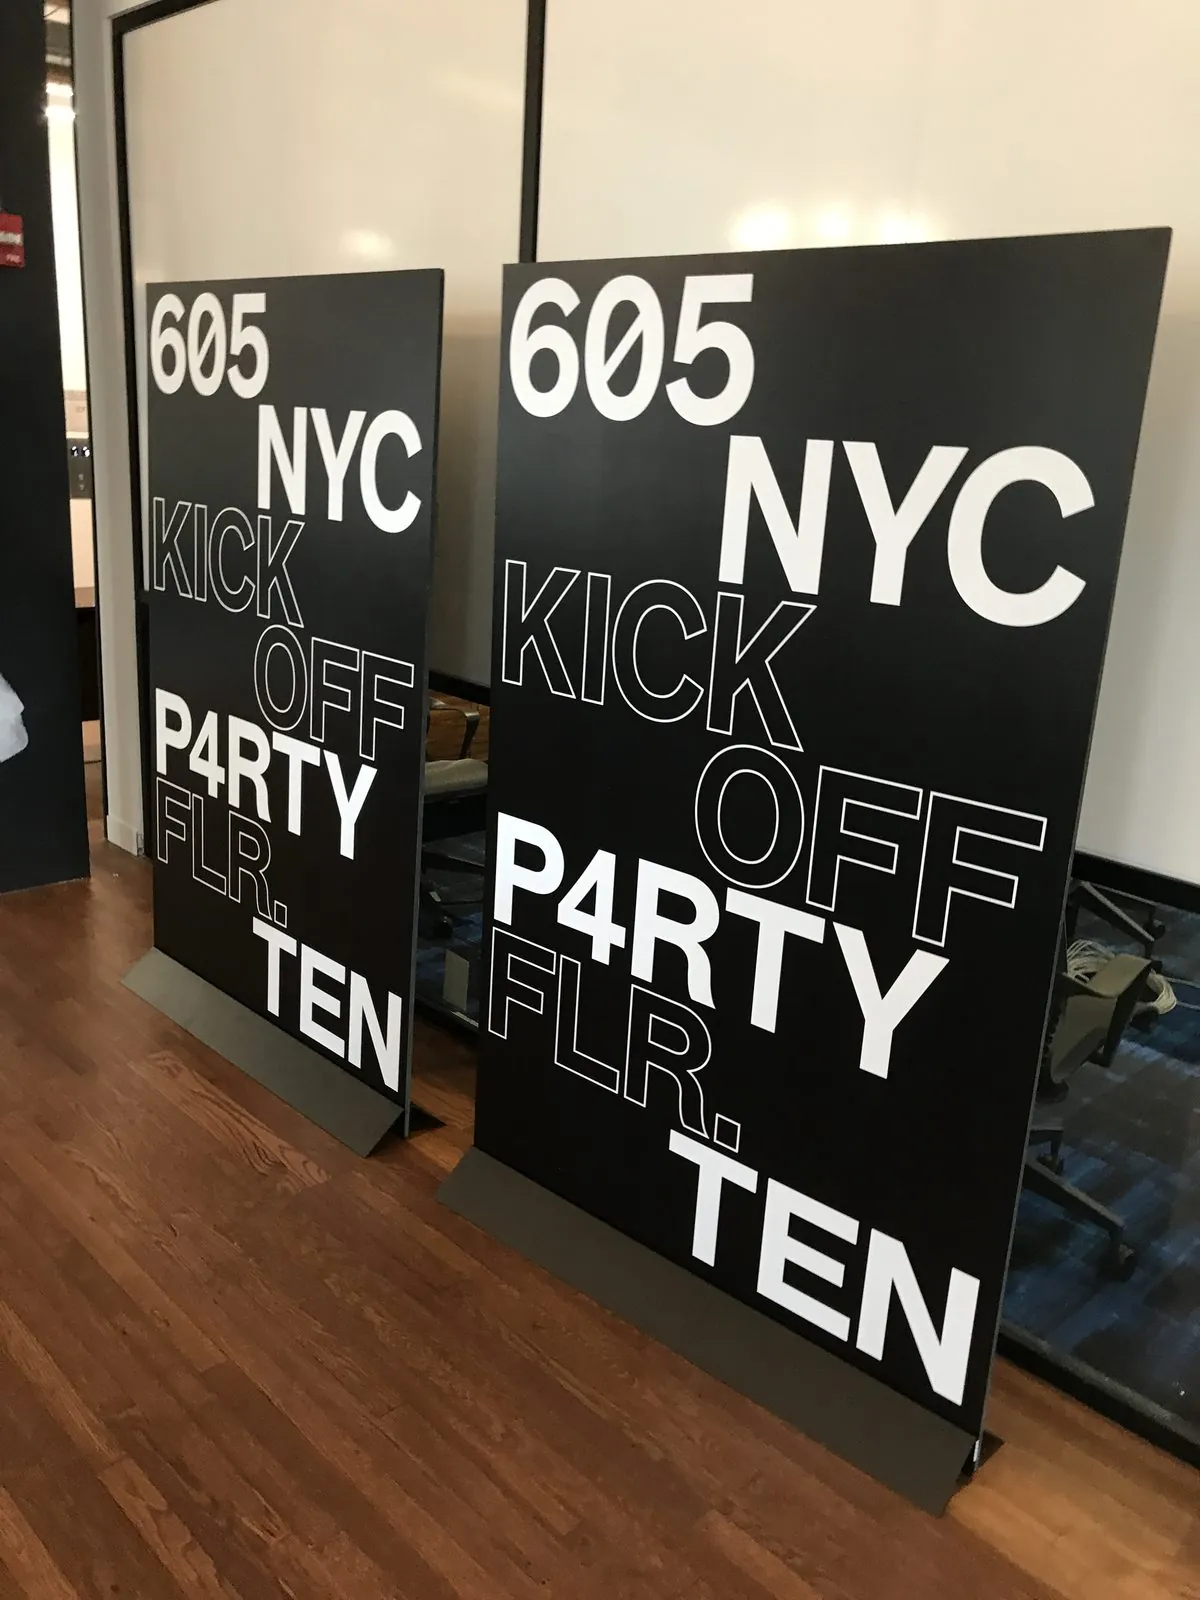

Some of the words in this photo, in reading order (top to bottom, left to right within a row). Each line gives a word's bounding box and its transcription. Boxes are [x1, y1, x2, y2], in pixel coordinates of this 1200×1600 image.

[150, 292, 269, 399] 605
[509, 273, 754, 426] 605
[257, 404, 422, 533] NYC
[718, 435, 1095, 627] NYC
[153, 497, 305, 628] KICK
[254, 624, 414, 761] OFF
[502, 559, 817, 752] KICK
[155, 688, 377, 860] P4RTY
[156, 777, 287, 928] FLR.
[695, 744, 1047, 947] OFF
[252, 917, 402, 1092] TEN
[493, 812, 949, 1079] P4RTY
[488, 927, 741, 1152] FLR.
[669, 1130, 980, 1406] TEN
